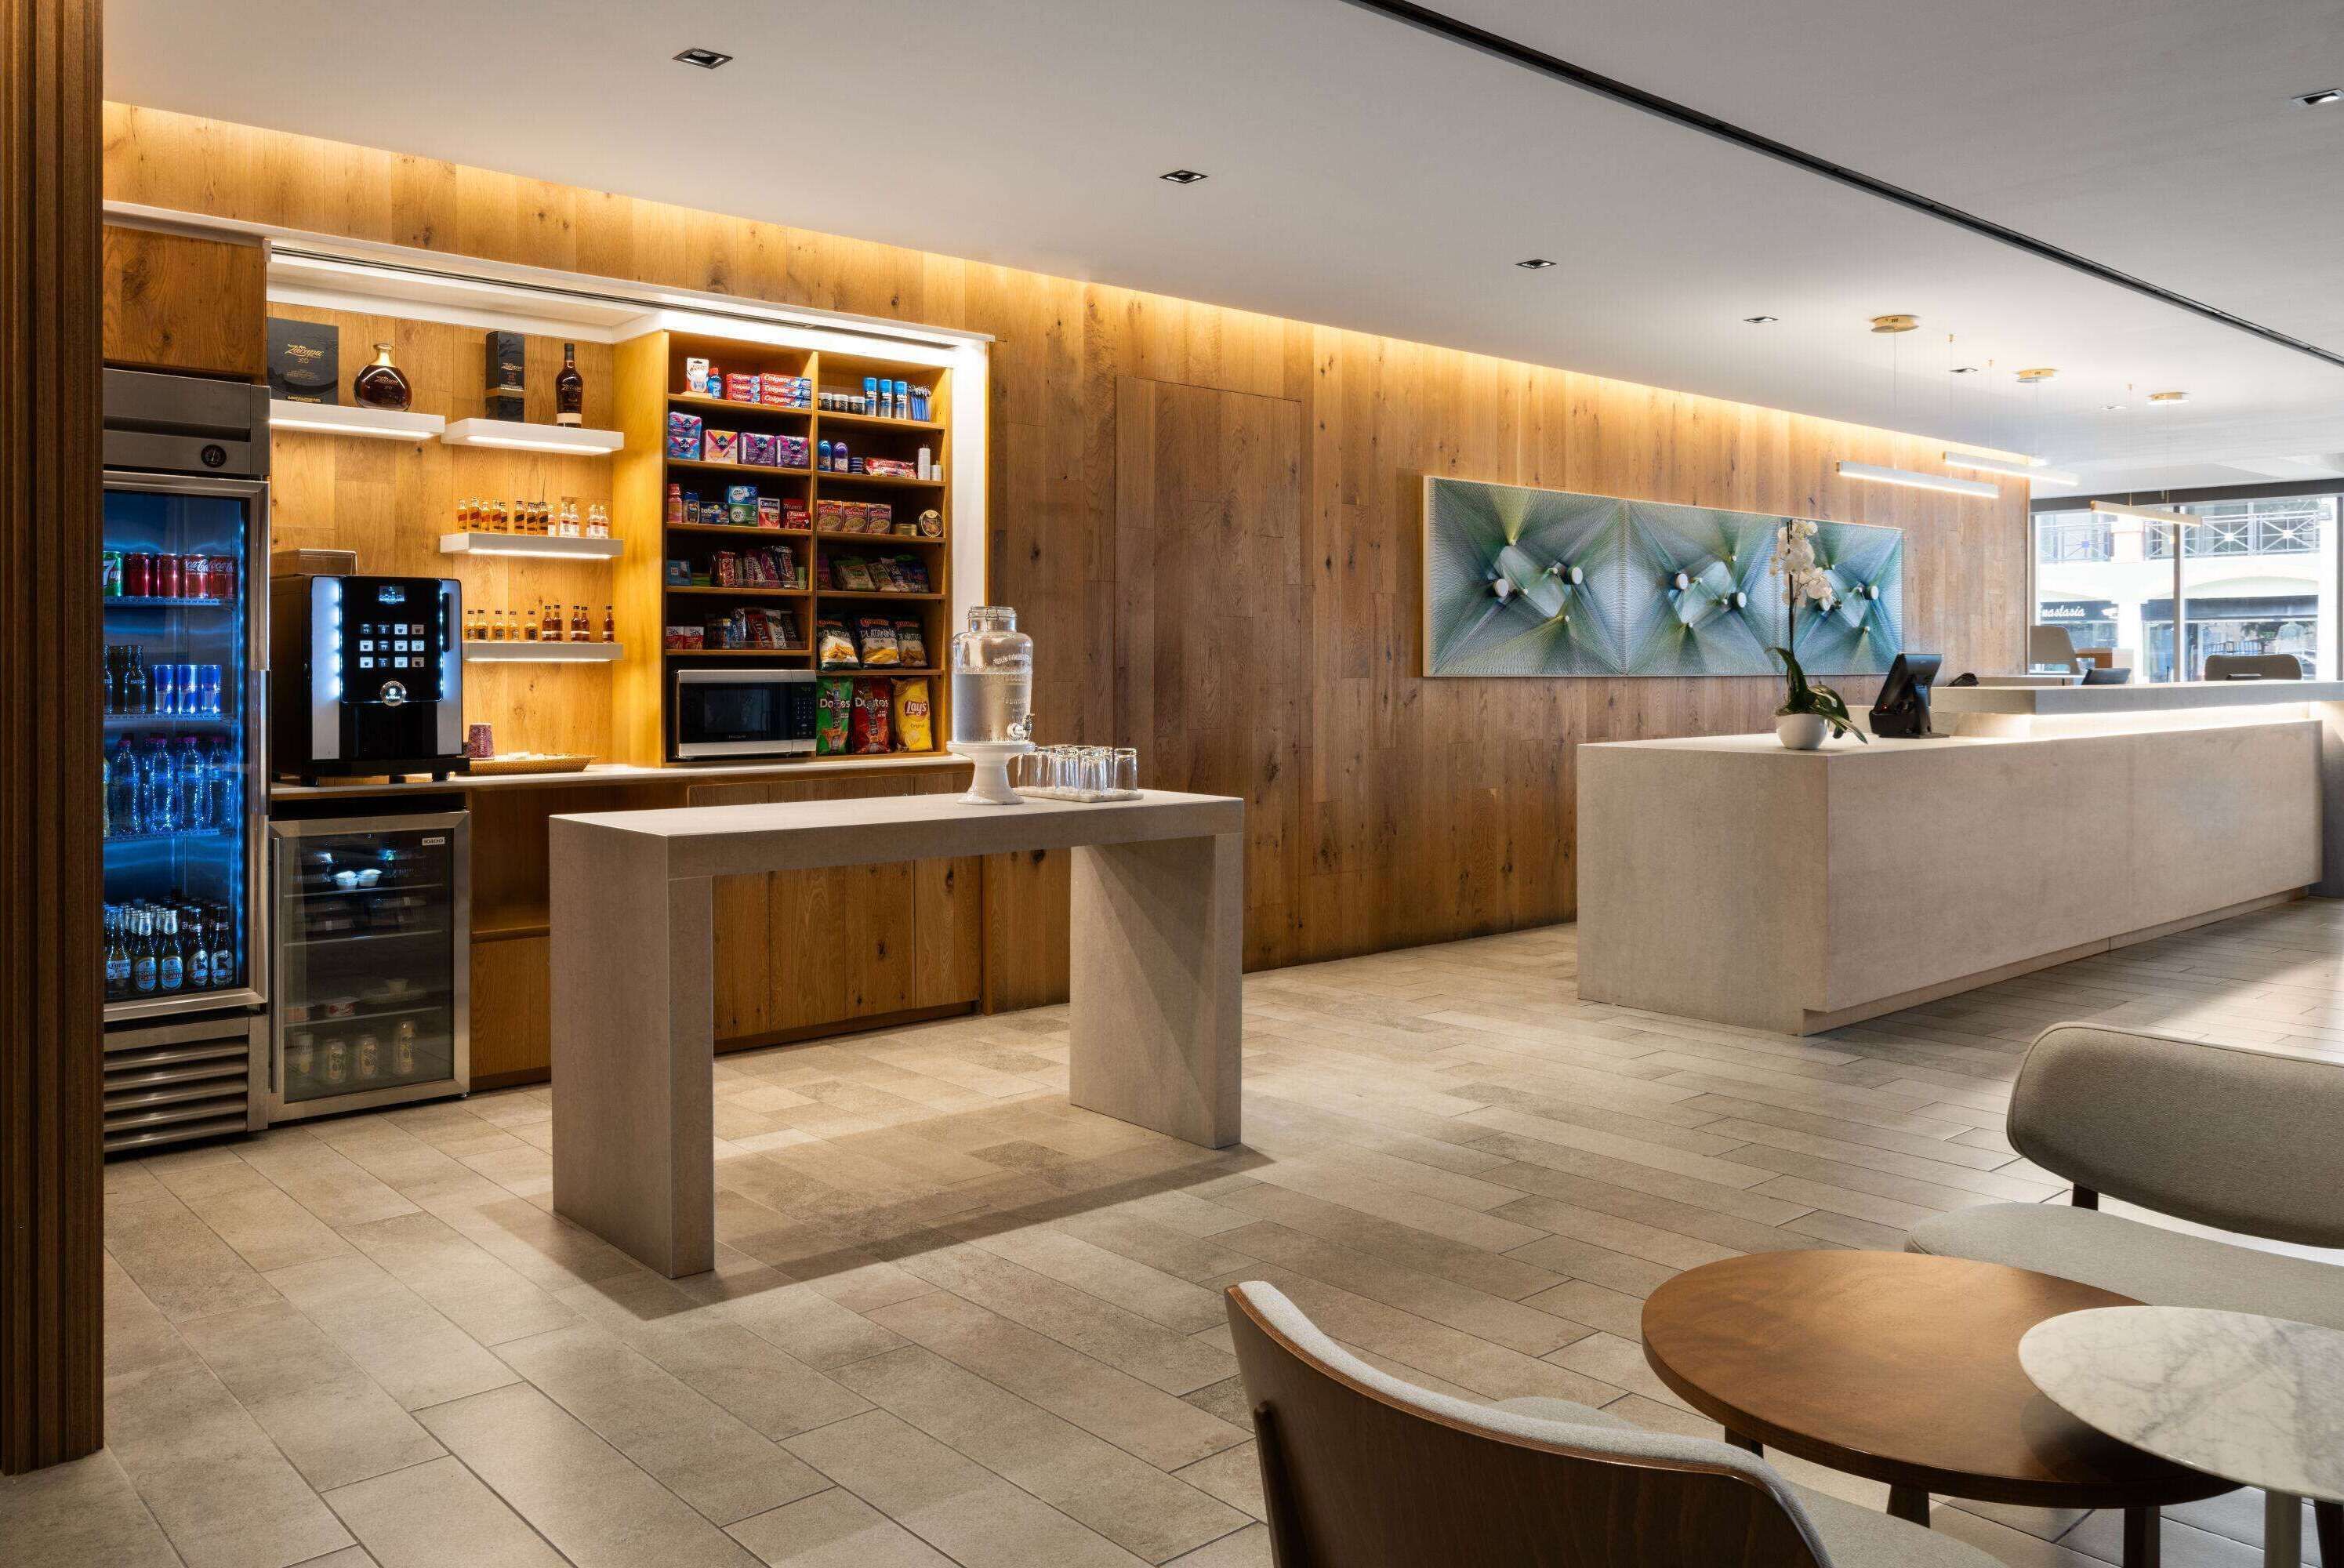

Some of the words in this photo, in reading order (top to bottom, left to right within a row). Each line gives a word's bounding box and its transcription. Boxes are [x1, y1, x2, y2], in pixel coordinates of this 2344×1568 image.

[764, 374, 791, 383] Colgate
[764, 385, 790, 394] Colgate
[764, 394, 791, 404] Colgate
[2040, 604, 2086, 618] nastasia
[907, 701, 927, 715] Lay's
